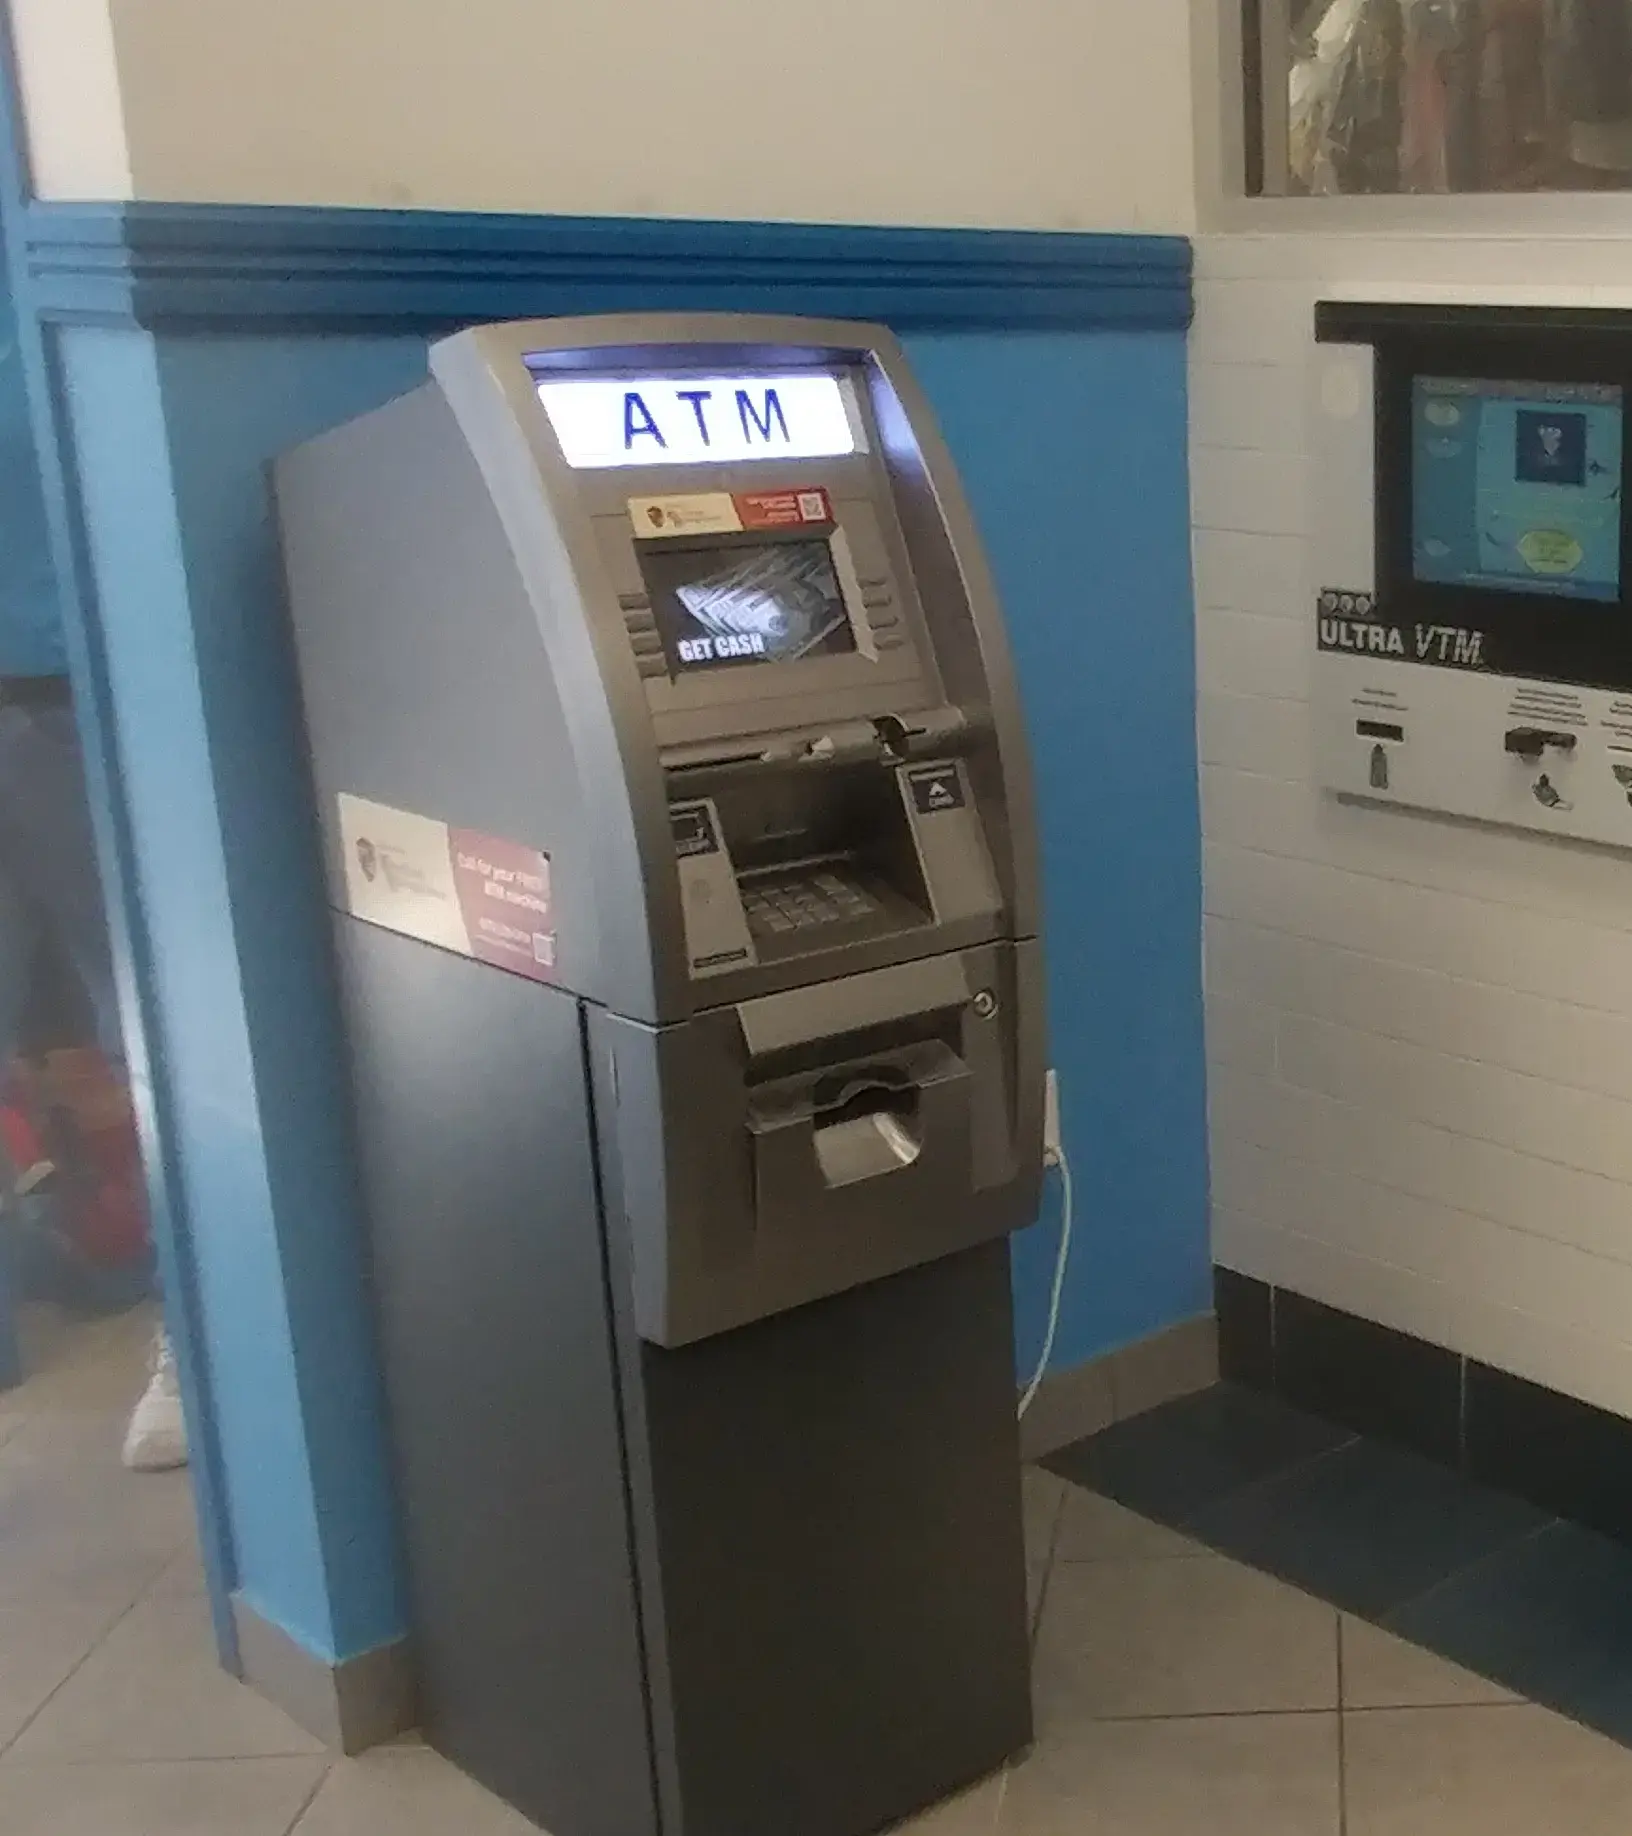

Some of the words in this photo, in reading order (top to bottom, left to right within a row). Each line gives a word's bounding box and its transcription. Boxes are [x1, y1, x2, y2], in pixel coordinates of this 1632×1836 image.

[624, 388, 791, 450] ATM
[677, 638, 715, 662] GET
[714, 632, 766, 658] CASH
[1321, 619, 1405, 654] ULTRA
[1415, 622, 1485, 665] VTM
